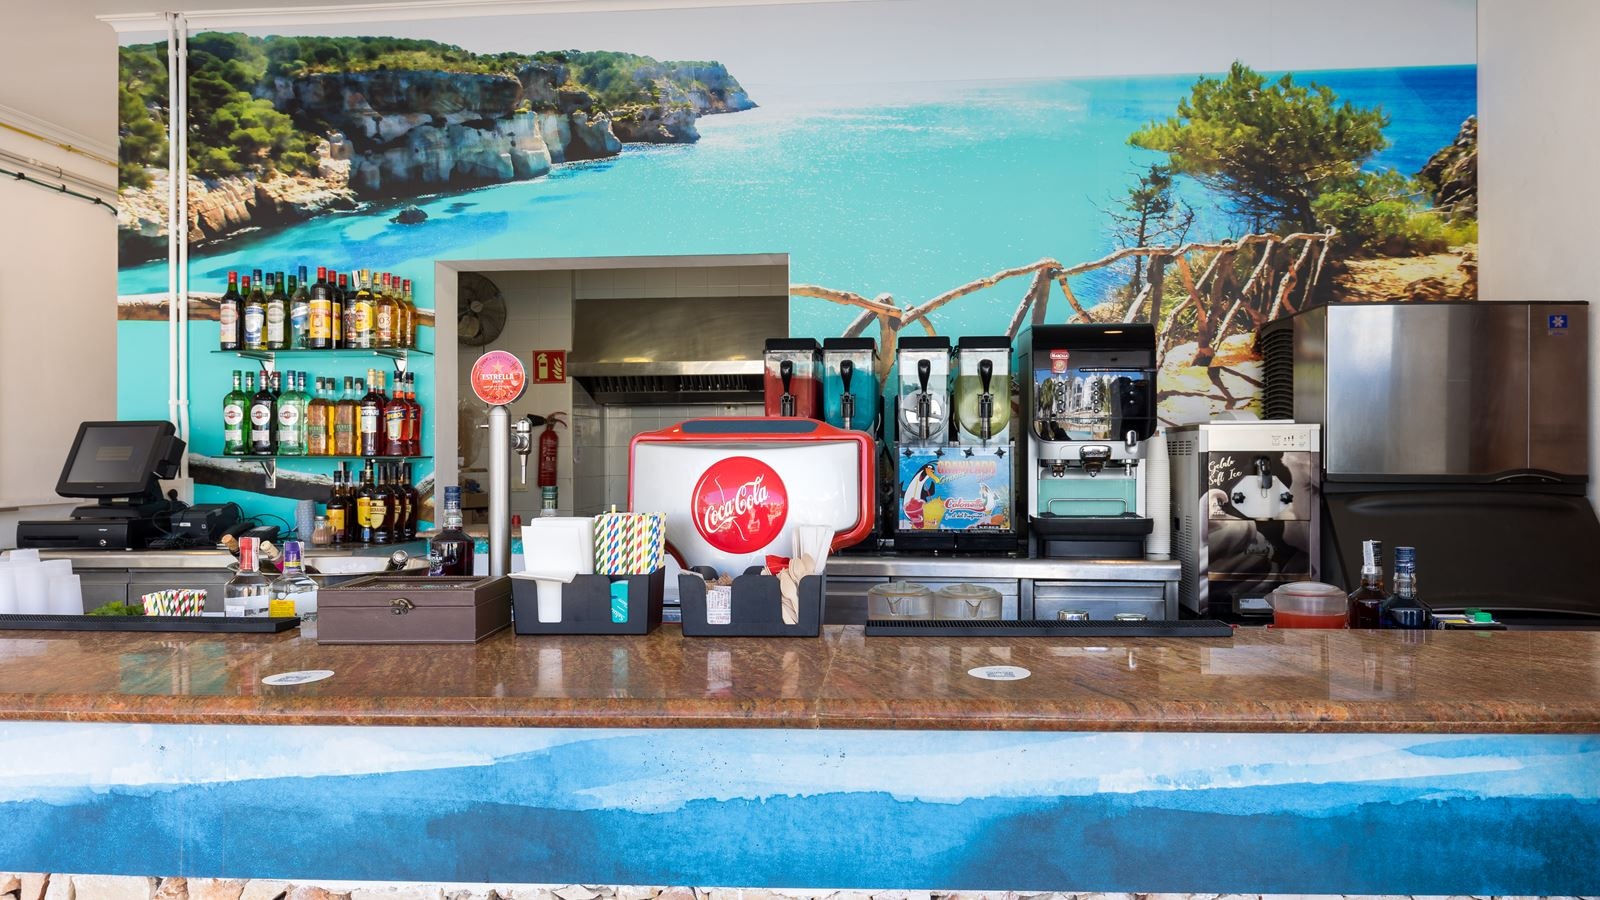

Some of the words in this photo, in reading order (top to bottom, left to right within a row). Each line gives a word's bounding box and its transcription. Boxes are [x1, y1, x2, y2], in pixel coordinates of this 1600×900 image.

[1208, 471, 1225, 486] Soft
[1228, 468, 1243, 480] Ice
[704, 474, 769, 534] Coca-Cola
